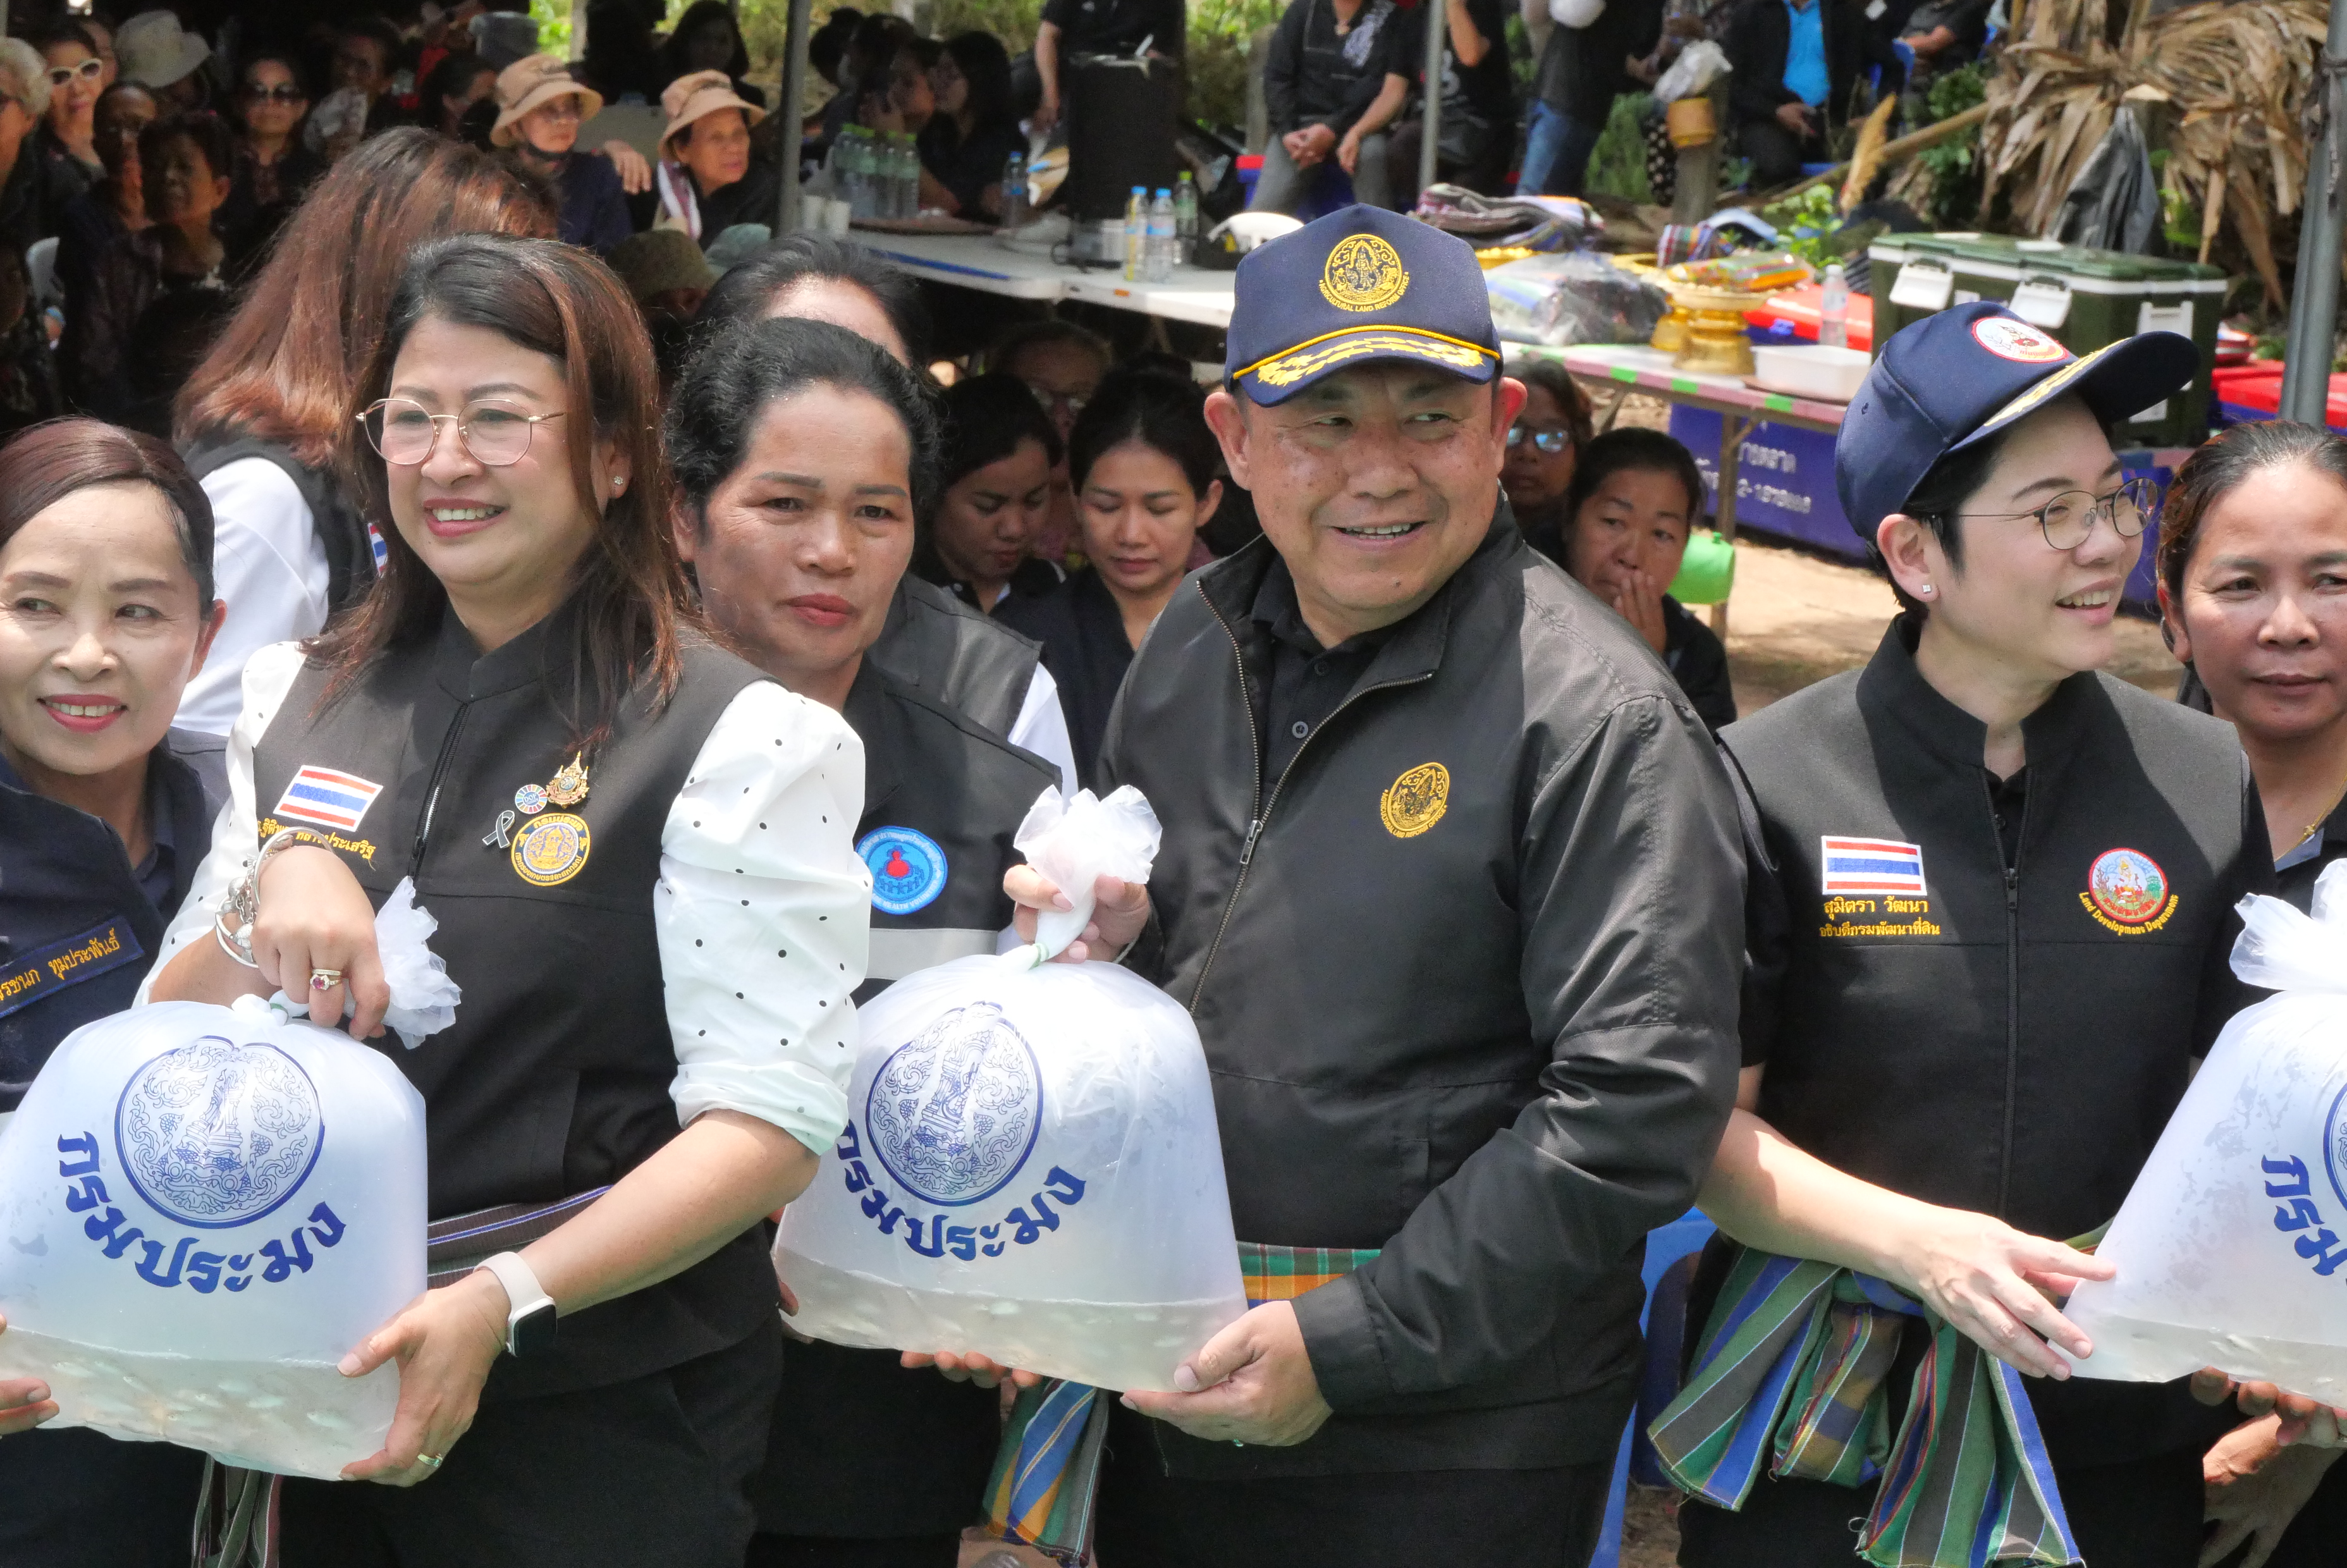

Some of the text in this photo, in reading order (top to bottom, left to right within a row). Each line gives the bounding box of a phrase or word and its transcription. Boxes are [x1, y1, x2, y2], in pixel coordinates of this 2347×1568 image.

[1319, 283, 1354, 312] AGRICULTURAL
[1375, 293, 1400, 310] REFORM
[1397, 275, 1410, 295] OFFICE
[524, 793, 537, 802] DOF
[1824, 895, 1928, 921] สุมิตรา วัฒนา
[2079, 892, 2097, 912] Land
[1819, 917, 1940, 937] อธิบดีกรมพัฒนาที่ดิน
[836, 1118, 1086, 1261] กรมประมง
[57, 1130, 346, 1294] กรมประมง
[2261, 1154, 2347, 1283] กรม
